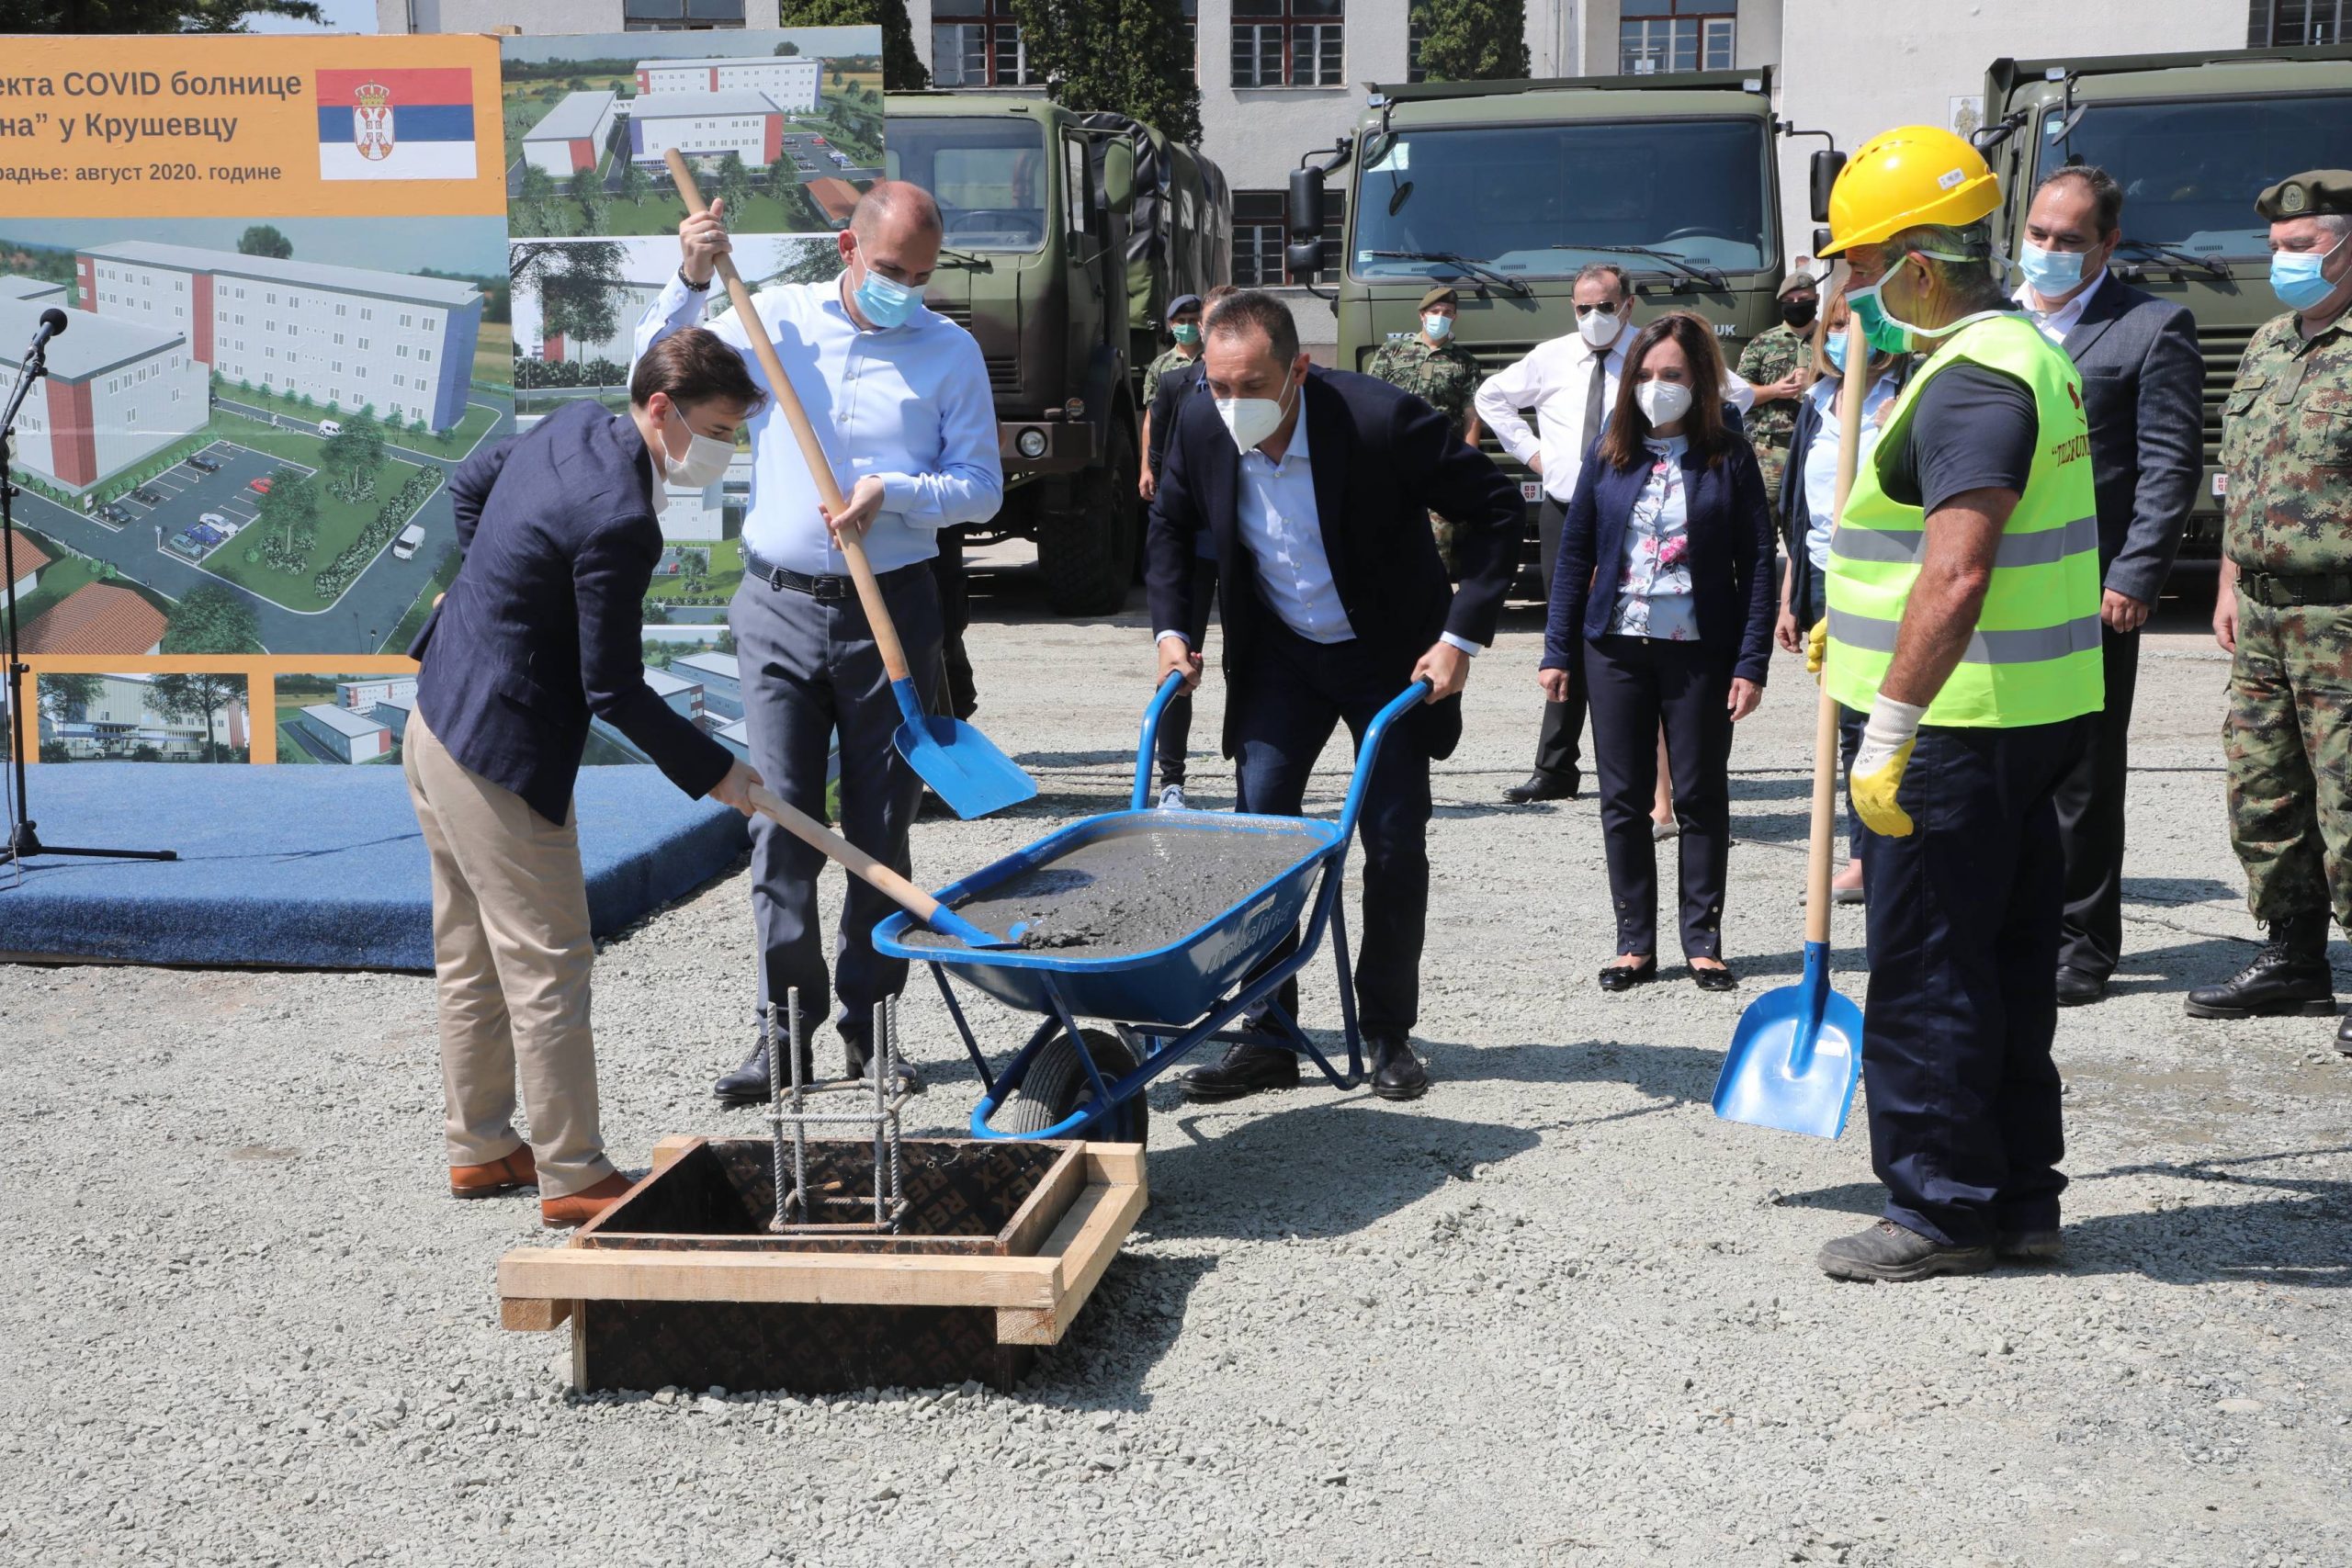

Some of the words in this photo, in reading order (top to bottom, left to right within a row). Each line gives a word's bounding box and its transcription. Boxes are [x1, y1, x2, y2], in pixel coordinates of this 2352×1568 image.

[63, 72, 161, 96] COVID
[171, 70, 301, 101] болнице
[59, 118, 75, 143] у
[85, 113, 238, 143] Крушевцу
[75, 166, 142, 185] август
[149, 164, 202, 181] 2020.
[209, 165, 282, 185] године
